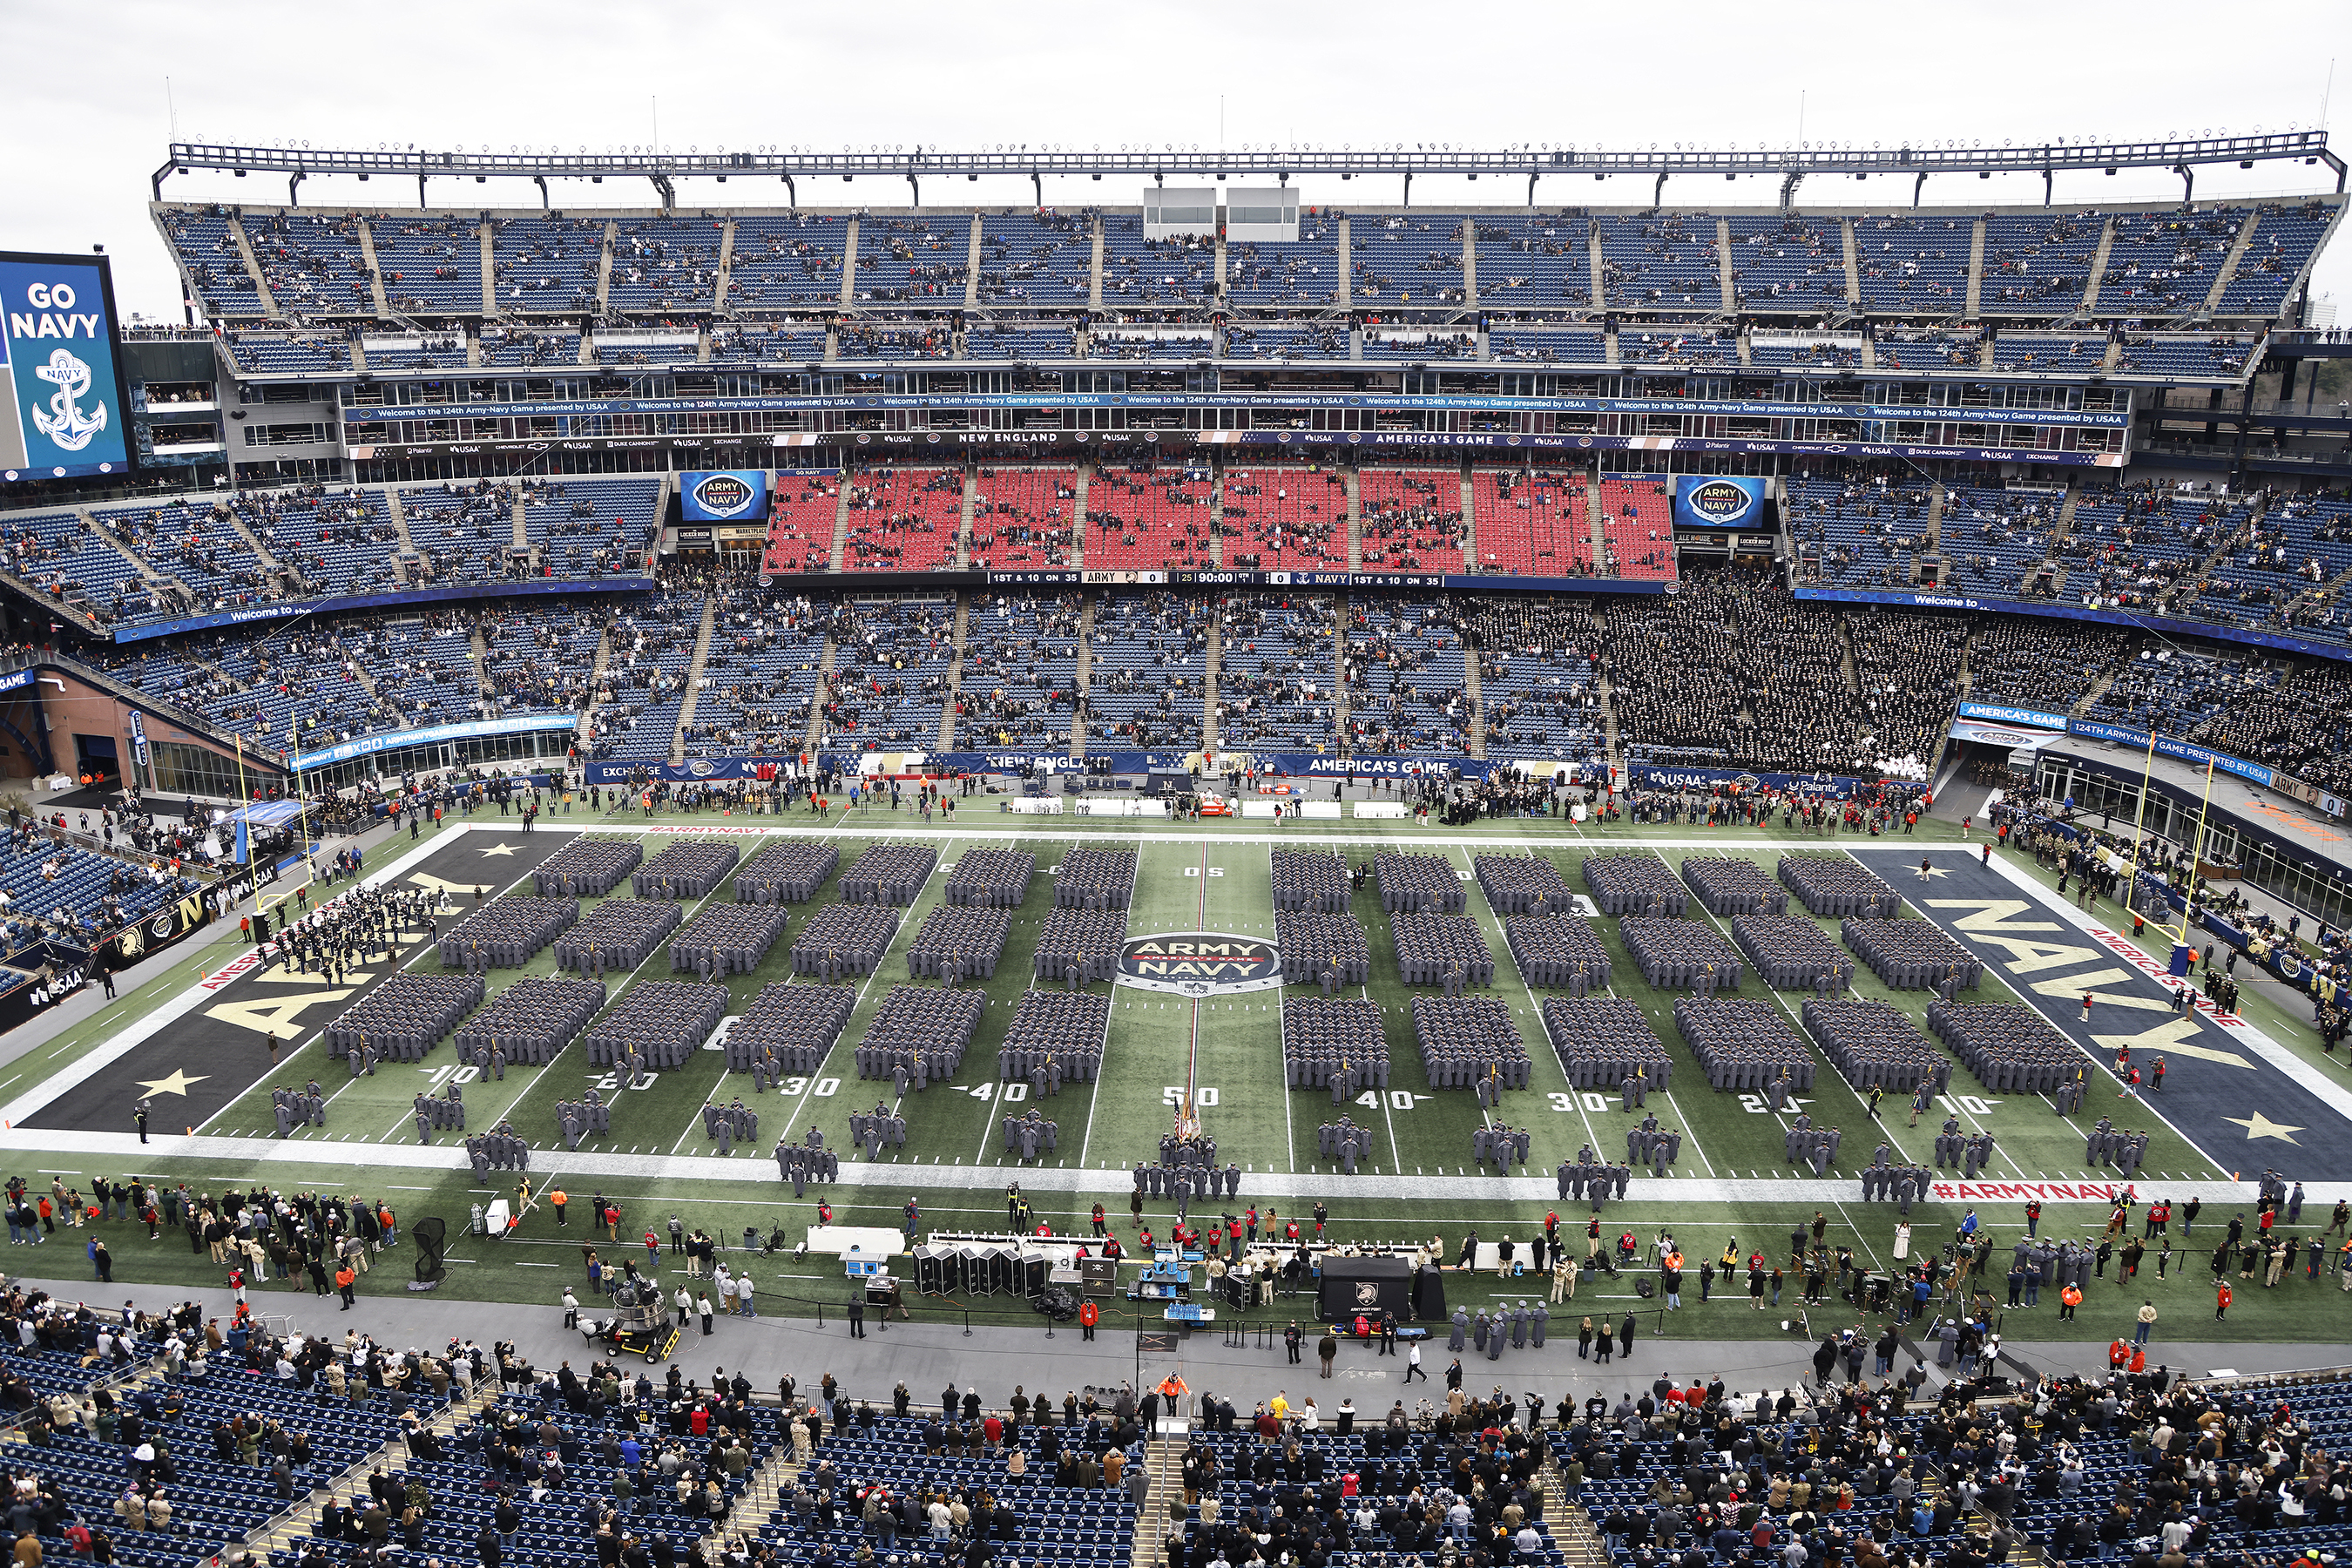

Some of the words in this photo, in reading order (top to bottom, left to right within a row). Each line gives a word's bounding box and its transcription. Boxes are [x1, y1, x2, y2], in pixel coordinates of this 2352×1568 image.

[28, 282, 76, 308] GO
[10, 313, 99, 338] NAVY
[47, 369, 82, 382] NAVY
[719, 399, 760, 409] Army-Navy
[785, 398, 821, 408] presented
[822, 398, 832, 407] by
[1208, 396, 1248, 405] Army-Navy
[1274, 396, 1309, 405] presented
[1311, 396, 1321, 405] by
[378, 408, 416, 416] Welcome
[466, 404, 509, 415] Army-Navy
[536, 402, 573, 412] presented
[575, 402, 584, 411] by
[1699, 403, 1741, 413] Army-Navy
[1768, 404, 1806, 414] presented
[1808, 405, 1818, 414] by
[1963, 410, 2009, 421] Army-Navy
[2038, 412, 2080, 422] presented
[2083, 414, 2092, 422] by
[1376, 435, 1455, 443] AMERICA'S
[1991, 451, 2012, 460] USAA
[707, 483, 738, 491] ARMY
[1704, 502, 1735, 510] NAVY
[1087, 573, 1115, 582] ARMY
[1149, 573, 1156, 582] 0
[1199, 573, 1233, 582] 90:00
[1315, 574, 1348, 584] NAVY
[1915, 595, 1963, 606] Welcome
[231, 608, 278, 621] Welcome
[0, 673, 26, 690] GAME
[1967, 706, 2030, 721] AMERICA'S
[2032, 713, 2066, 727] GAME
[385, 725, 470, 746] ARMYNAVYGAME.COM
[2075, 723, 2104, 733] 124TH
[2159, 742, 2185, 754] GAME
[2186, 747, 2235, 768] PRESENTED
[2236, 761, 2247, 772] BY
[2249, 765, 2268, 781] USAA
[1309, 759, 1397, 772] AMERICA'S
[1667, 774, 1700, 786] USAA
[1801, 781, 1839, 793] Palantir
[2274, 779, 2300, 796] ARMY
[2328, 799, 2335, 812] 0
[650, 826, 771, 835] #ARMYNAVY
[1134, 942, 1260, 955] ARMY
[2087, 928, 2186, 990] AMERICA'S
[1138, 961, 1260, 976] NAVY
[1923, 899, 2258, 1070] NAVY
[430, 1064, 481, 1084] 10
[781, 1077, 841, 1097] 30
[969, 1082, 1028, 1102] 40
[1162, 1086, 1218, 1106] 50
[1355, 1090, 1415, 1110] 40
[1547, 1092, 1608, 1112] 30
[1936, 1095, 1993, 1115] 10
[640, 1413, 648, 1422] 10
[1808, 1443, 1818, 1453] 94
[2211, 1489, 2220, 1499] 13
